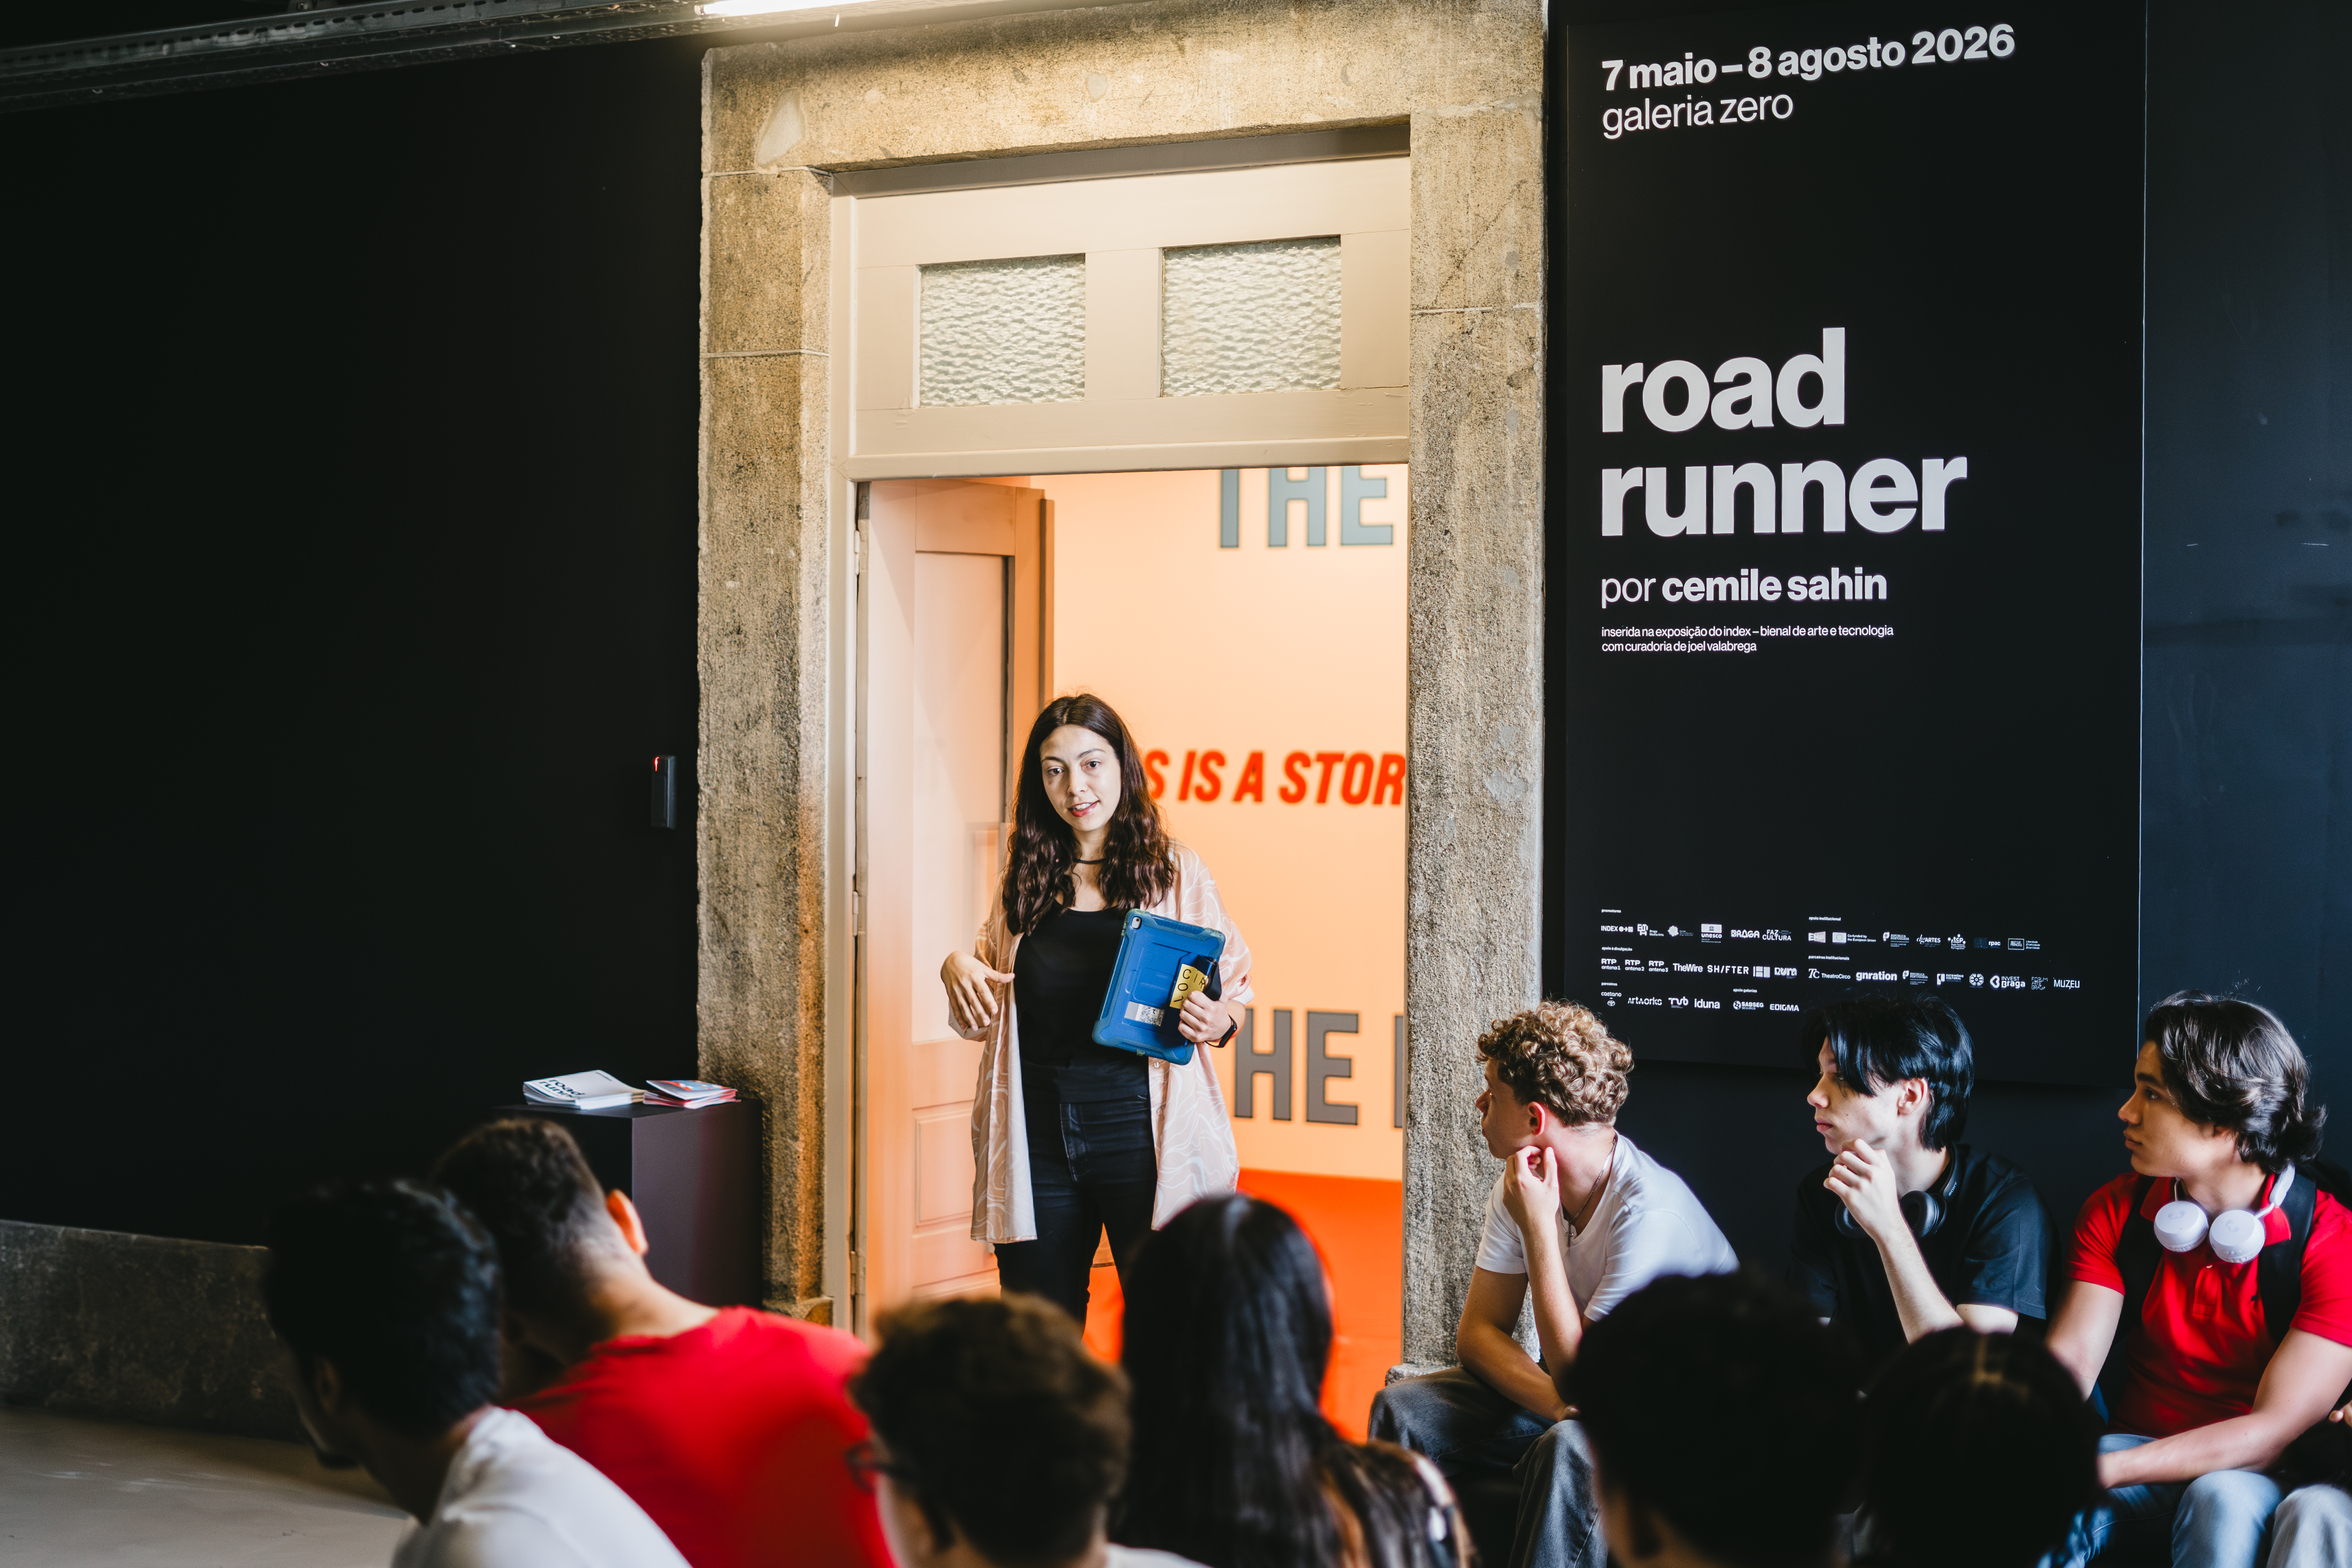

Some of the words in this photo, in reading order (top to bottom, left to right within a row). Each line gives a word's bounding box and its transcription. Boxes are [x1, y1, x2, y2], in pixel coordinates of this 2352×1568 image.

[1602, 59, 1623, 91] 7
[1629, 52, 1717, 89] maio
[1748, 46, 1772, 79] 8
[1778, 37, 1906, 81] agosto
[1911, 24, 2015, 64] 2026
[1602, 94, 1714, 139] galeria
[1719, 94, 1794, 124] zero
[1602, 327, 1845, 433] road
[1601, 456, 1967, 537] runner
[1601, 578, 1656, 609] por
[1662, 568, 1782, 602] cemile
[1787, 567, 1887, 601] sahin
[1601, 626, 1641, 637] inserida
[1642, 628, 1655, 637] na
[1655, 626, 1707, 639] exposição
[1708, 625, 1722, 637] do
[1723, 625, 1752, 637] index
[1760, 625, 1791, 637] bienal
[1792, 625, 1806, 636] de
[1807, 625, 1829, 636] arte
[1830, 627, 1837, 636] e
[1838, 625, 1894, 638] tecnologia
[1601, 643, 1624, 652] com
[1625, 641, 1673, 652] curadoria
[1673, 641, 1687, 652] de
[1687, 641, 1706, 653] joel
[1707, 640, 1757, 653] valabrega
[1178, 749, 1225, 801] IS
[1233, 751, 1264, 802] A
[1856, 971, 1897, 981] gnration
[2001, 981, 2026, 989] Braga
[1694, 998, 1720, 1009] iduna
